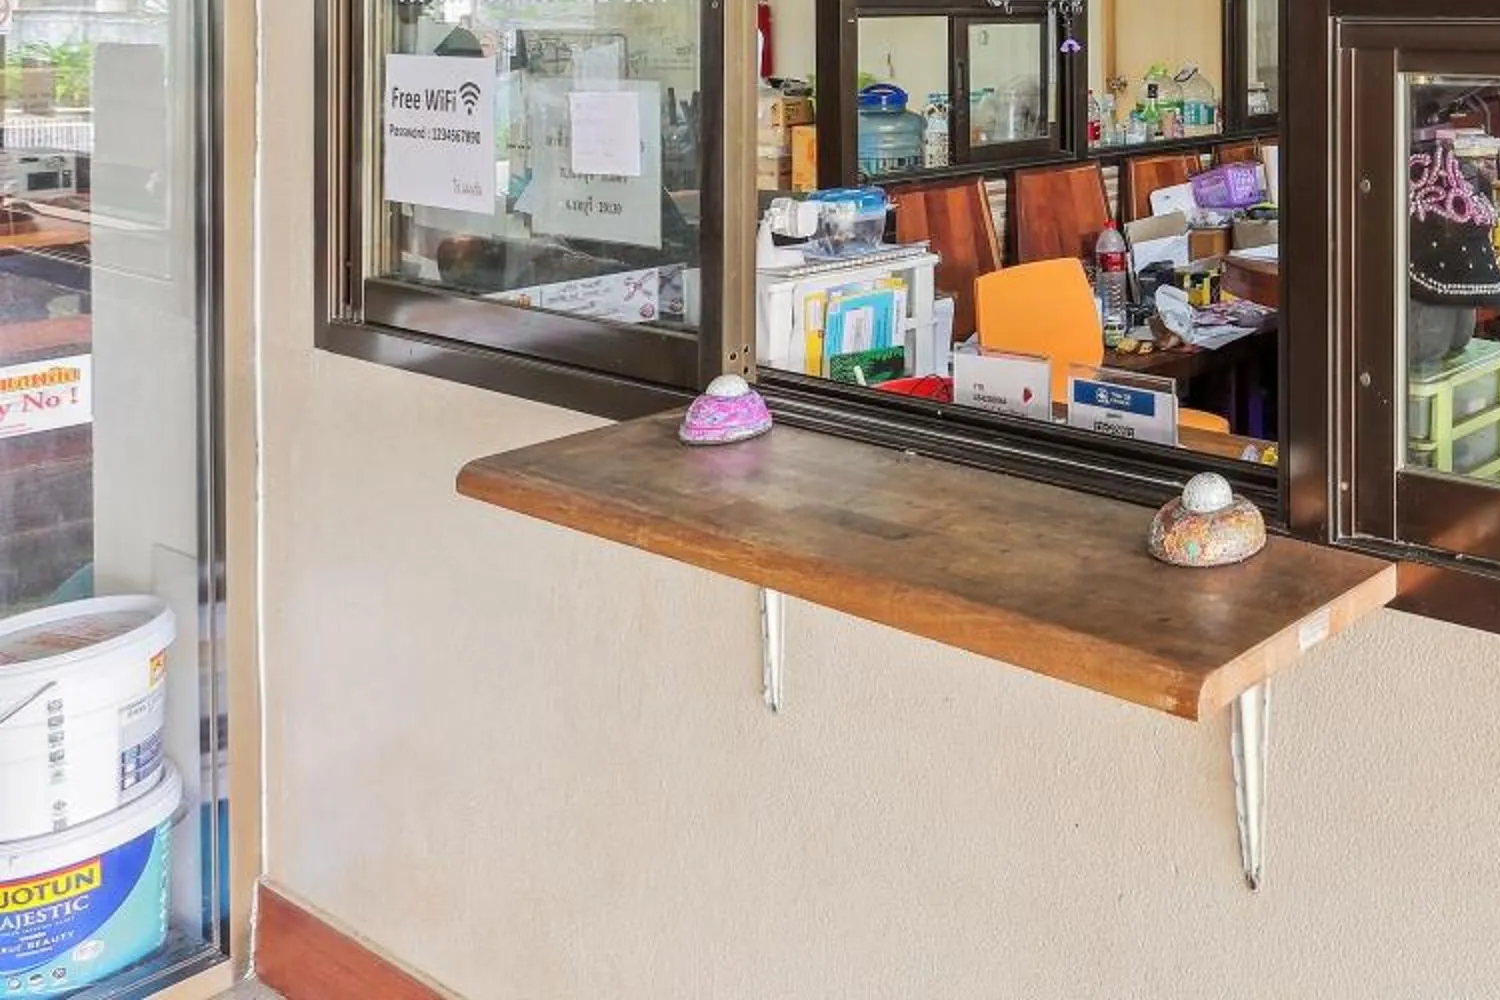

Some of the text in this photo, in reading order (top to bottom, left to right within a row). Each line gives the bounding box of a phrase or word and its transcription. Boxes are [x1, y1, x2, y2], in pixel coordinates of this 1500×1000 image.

[391, 86, 457, 113] Free WiFi
[0, 867, 95, 909] JOTUN
